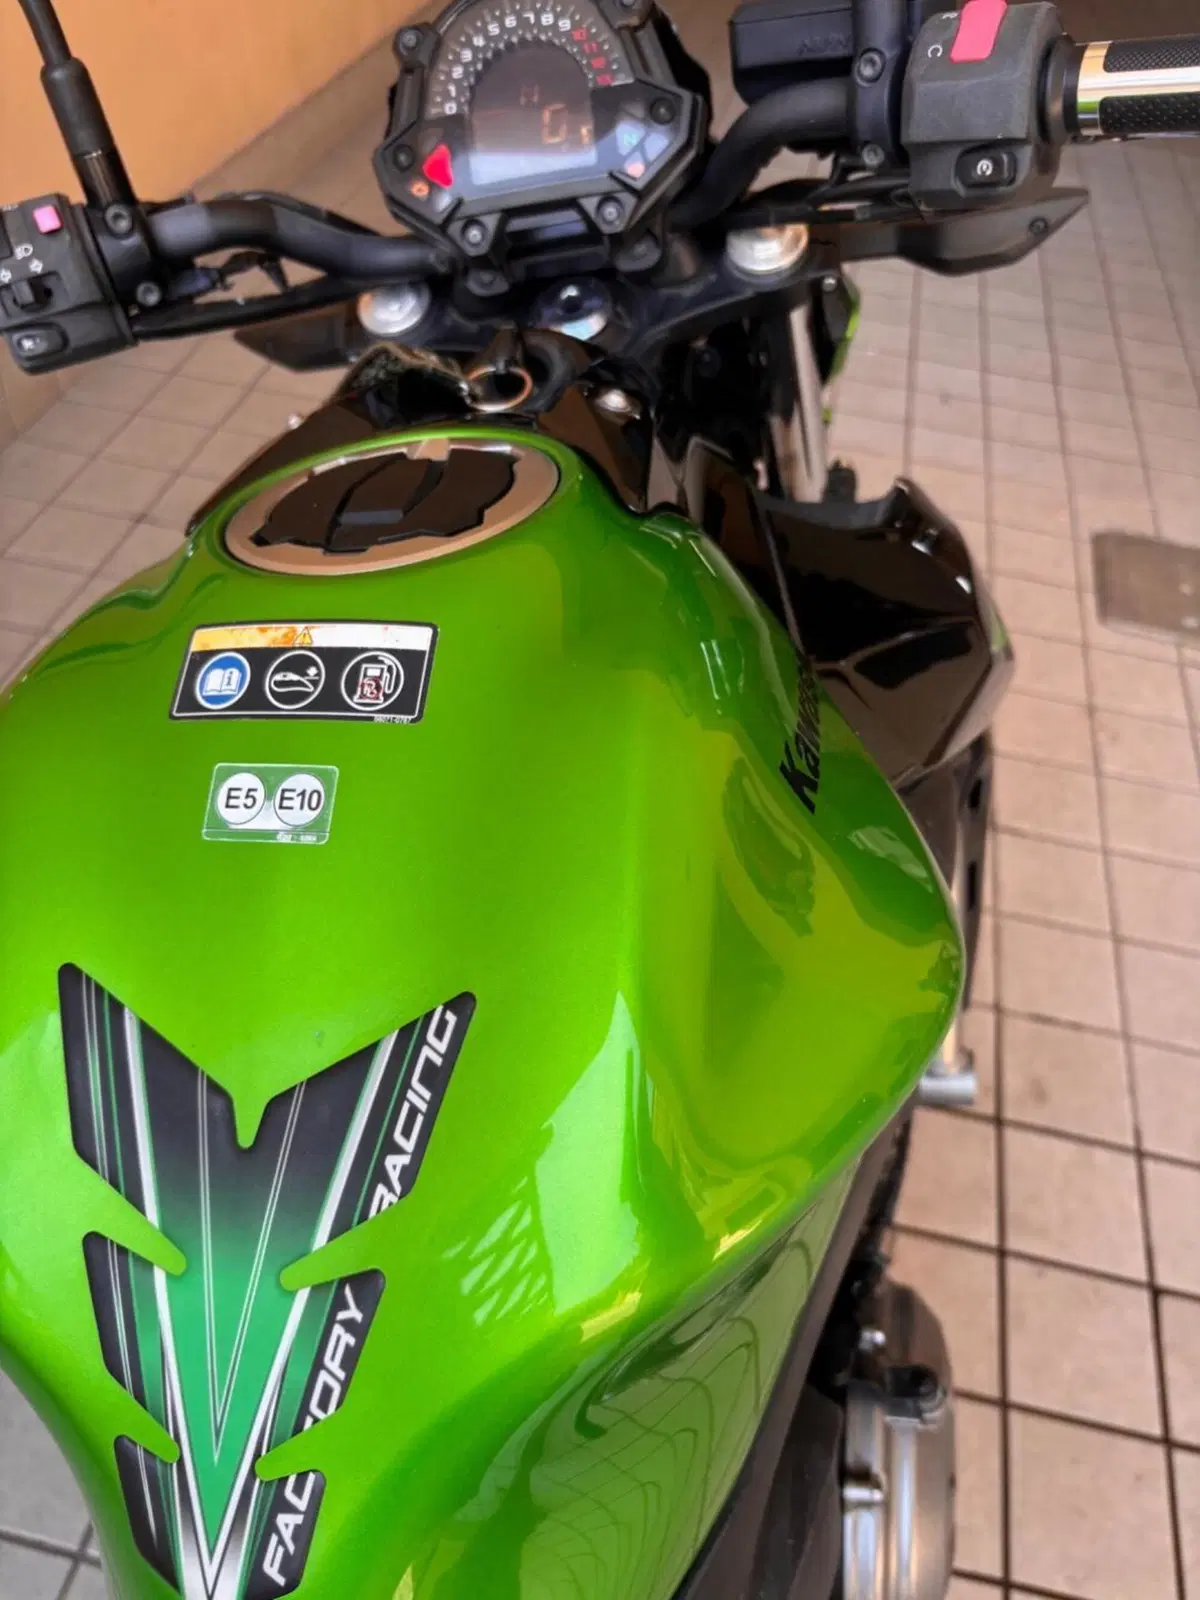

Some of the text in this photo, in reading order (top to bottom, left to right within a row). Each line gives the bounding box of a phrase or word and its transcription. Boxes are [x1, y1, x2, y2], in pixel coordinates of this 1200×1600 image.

[504, 15, 517, 28] 6
[523, 13, 535, 25] 7
[540, 13, 553, 26] 8
[558, 19, 571, 32] 9
[488, 22, 500, 36] 5
[472, 35, 485, 47] 4
[459, 49, 473, 62] 3
[451, 66, 464, 79] 2
[444, 102, 457, 115] 0
[224, 787, 322, 811] E5 E10
[367, 1004, 458, 1220] RACING
[262, 1282, 364, 1587] FACORY
